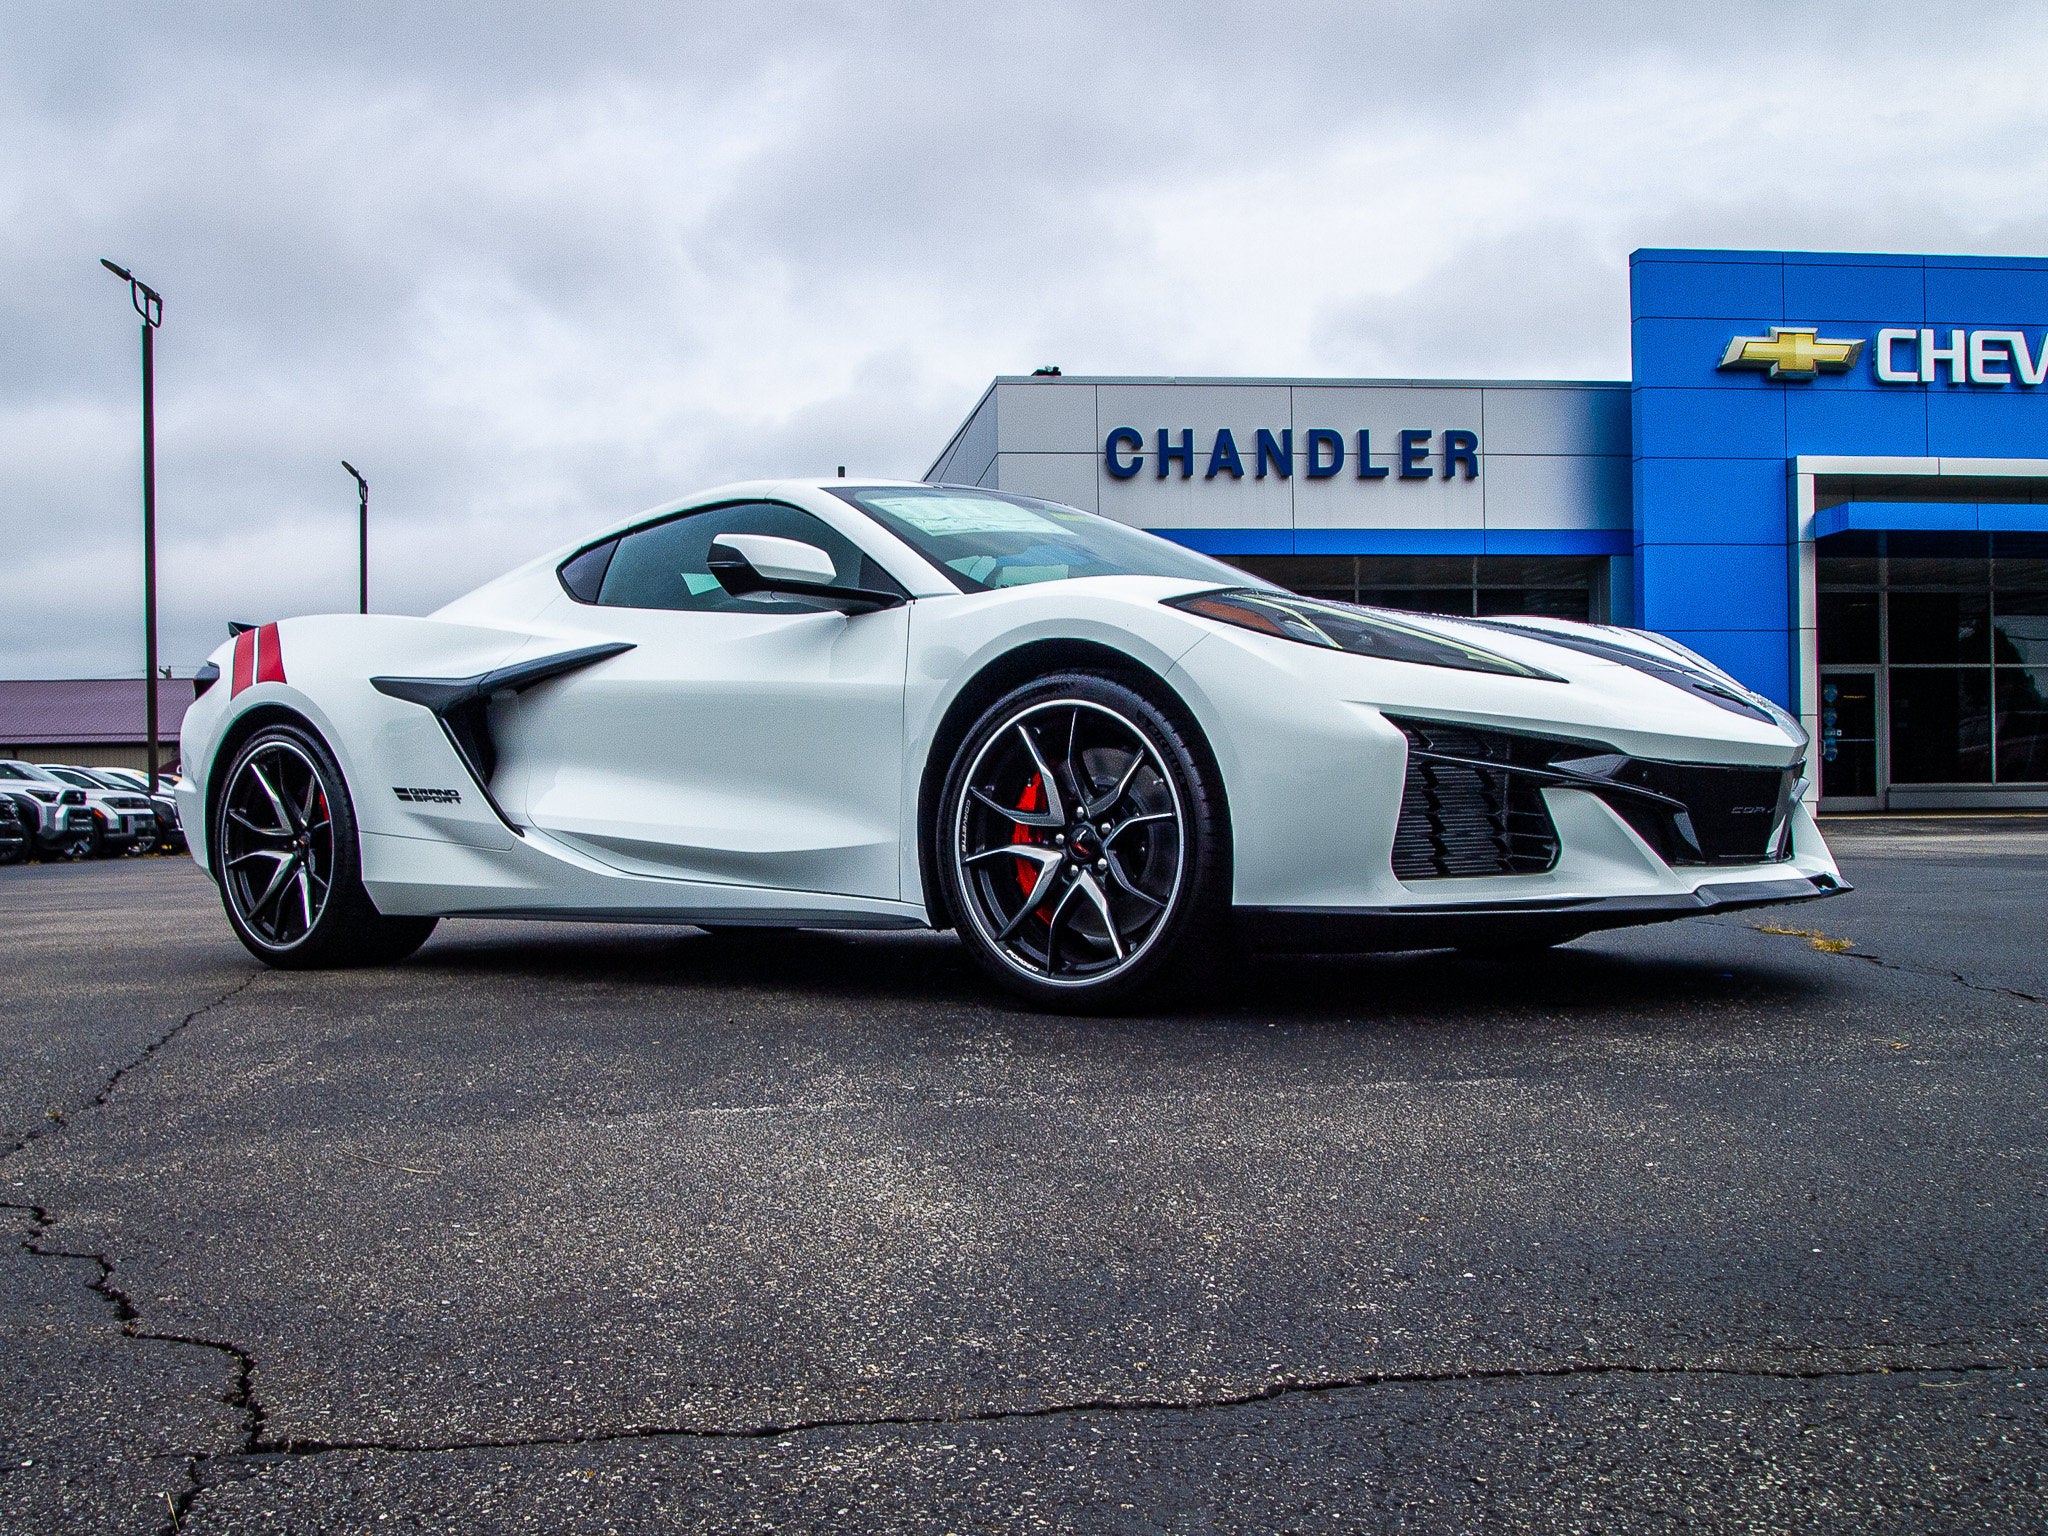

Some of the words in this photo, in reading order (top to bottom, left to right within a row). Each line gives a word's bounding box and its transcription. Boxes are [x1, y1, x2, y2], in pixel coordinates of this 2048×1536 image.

[1105, 427, 1480, 480] CHANDLER
[408, 787, 460, 796] GRAND
[412, 796, 462, 804] SPORT
[1006, 949, 1039, 972] FORGED
